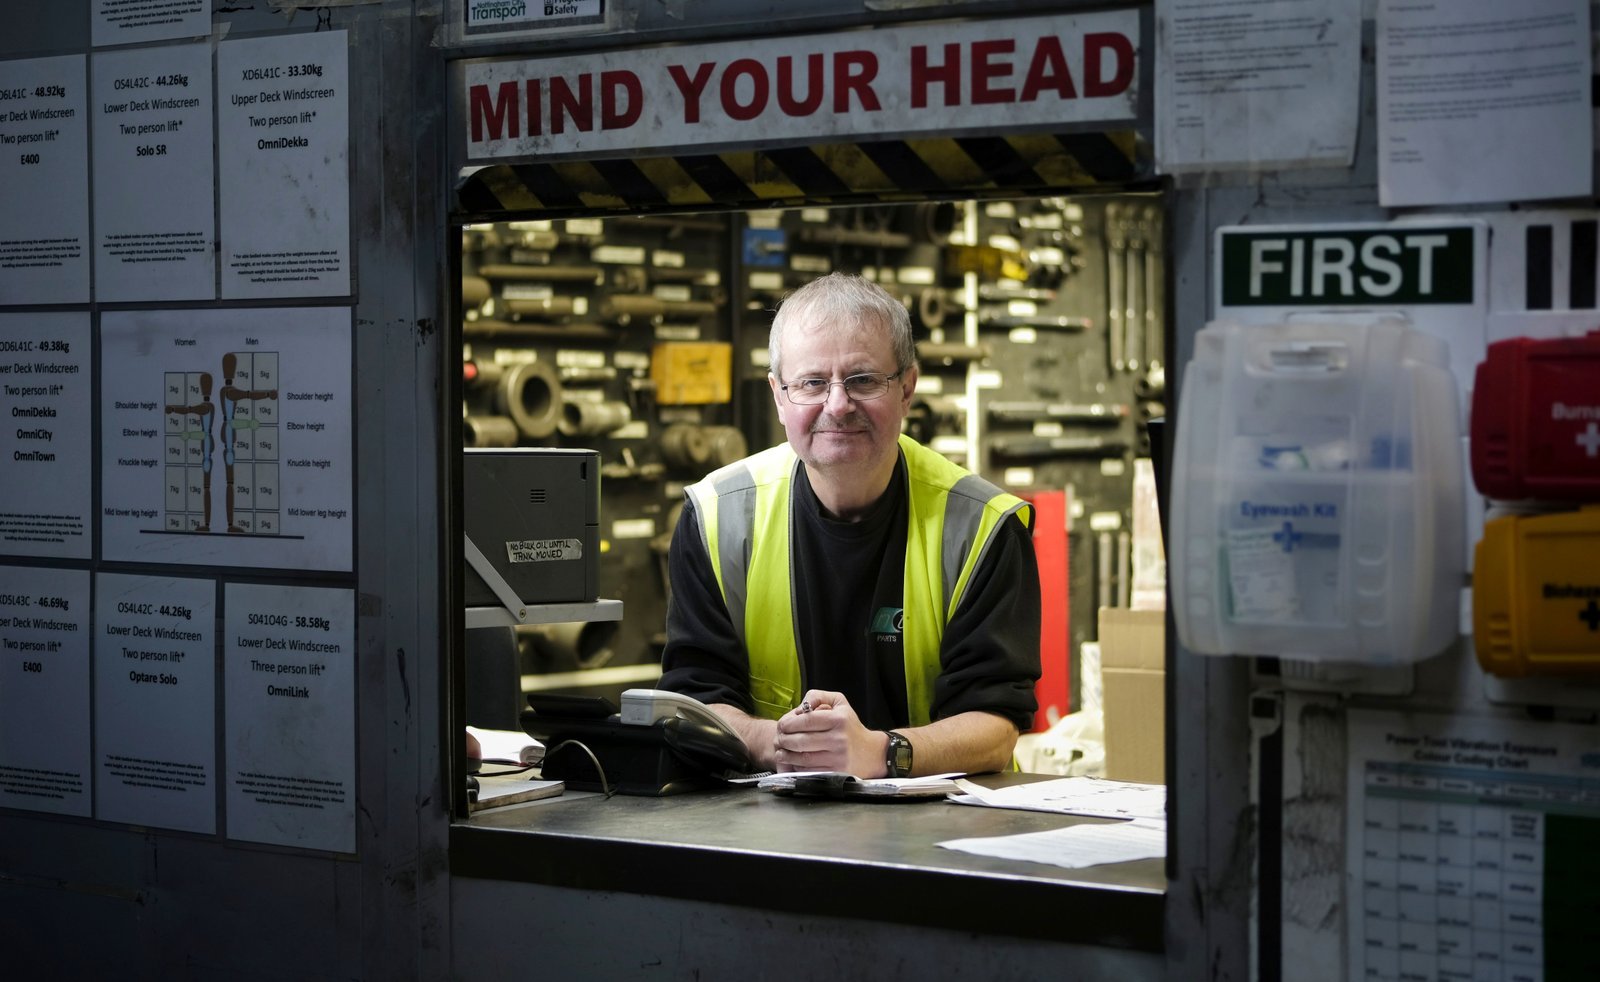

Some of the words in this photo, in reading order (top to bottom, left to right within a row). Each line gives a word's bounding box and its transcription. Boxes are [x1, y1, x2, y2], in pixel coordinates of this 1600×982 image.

[472, 4, 526, 21] Transport
[554, 5, 578, 14] Safety
[242, 68, 280, 80] XD6L41C
[288, 64, 323, 77] 33.30kg
[114, 77, 149, 90] OS4L42C
[156, 74, 188, 87] 44.26kg
[469, 69, 644, 143] MIND
[667, 49, 881, 125] YOUR
[910, 31, 1135, 109] HEAD
[35, 85, 65, 97] 48.92kg
[232, 94, 258, 107] Upper
[260, 91, 280, 103] Deck
[283, 88, 334, 100] Windscreen
[104, 103, 128, 114] Lower
[130, 101, 149, 111] Deck
[151, 98, 199, 110] Windscreen
[10, 110, 28, 122] Deck
[30, 108, 75, 120] Windscreen
[248, 116, 266, 127] Two
[269, 116, 298, 128] person
[120, 124, 136, 135] Two
[138, 123, 165, 136] person
[1, 134, 15, 144] Two
[18, 133, 43, 145] person
[258, 136, 308, 150] OmniDekka
[136, 145, 154, 156] Solo
[156, 144, 167, 155] SR
[21, 154, 40, 165] E400
[1249, 234, 1449, 298] FIRST
[39, 340, 70, 353] 49.38kg
[174, 338, 196, 347] Women
[14, 363, 32, 373] Deck
[34, 363, 79, 374] Windscreen
[4, 384, 20, 396] Two
[22, 386, 47, 397] person
[315, 392, 333, 401] height
[12, 407, 57, 418] OmniDekka
[115, 402, 138, 410] Shoulder
[140, 402, 157, 411] height
[287, 422, 305, 430] Elbow
[306, 422, 324, 431] height
[17, 428, 53, 442] OmniCity
[140, 429, 157, 438] height
[14, 450, 55, 462] OmniTown
[141, 459, 158, 467] height
[287, 459, 310, 468] Knuckle
[312, 460, 330, 468] height
[131, 510, 140, 518] leg
[140, 510, 158, 518] height
[317, 509, 326, 518] leg
[327, 510, 346, 518] height
[1240, 501, 1310, 520] Eyewash
[1313, 502, 1337, 517] Kit
[519, 542, 536, 550] BULK
[549, 540, 570, 548] UNTIL
[513, 552, 534, 560] TANK
[39, 596, 69, 611] 46.69kg
[118, 602, 152, 615] OS4L42C
[160, 605, 192, 620] 44.26kg
[13, 617, 31, 628] Deck
[33, 618, 78, 631] Windscreen
[296, 616, 330, 631] 58.58kg
[107, 624, 131, 635] Lower
[133, 626, 152, 638] Deck
[154, 627, 202, 642] Windscreen
[2, 638, 18, 649] Two
[20, 641, 46, 652] person
[238, 636, 263, 648] Lower
[266, 638, 286, 650] Deck
[289, 640, 340, 653] Windscreen
[122, 647, 138, 659] Two
[141, 651, 167, 662] person
[23, 662, 42, 672] E400
[250, 660, 275, 672] Three
[278, 664, 307, 675] person
[130, 671, 158, 684] Optare
[160, 673, 178, 685] Solo
[268, 685, 309, 698] OmniLink
[1454, 753, 1493, 767] Coding
[1497, 756, 1528, 768] Chart
